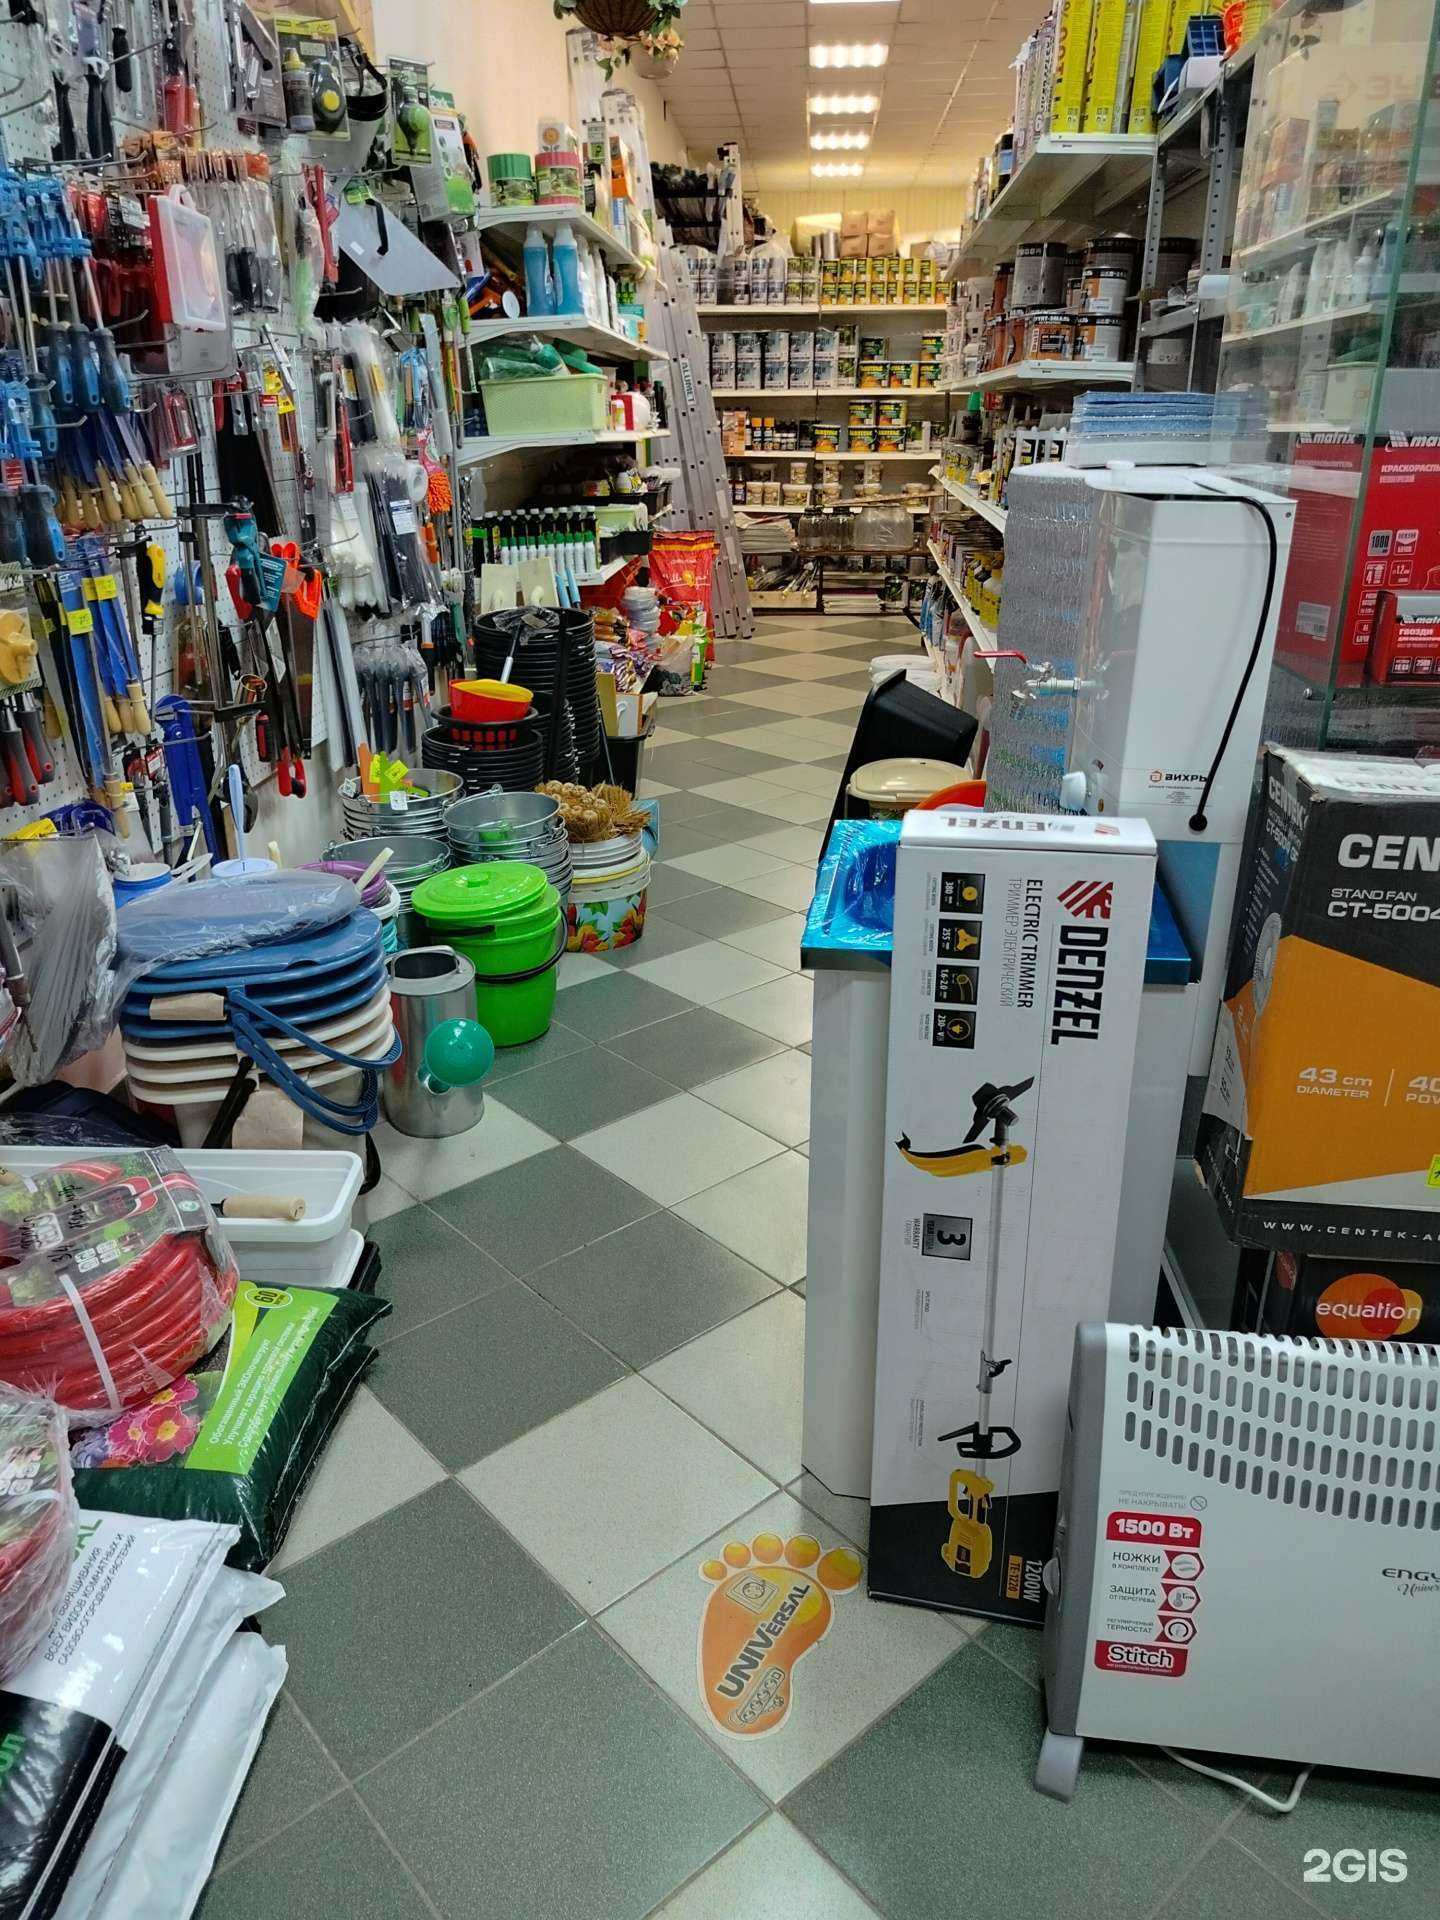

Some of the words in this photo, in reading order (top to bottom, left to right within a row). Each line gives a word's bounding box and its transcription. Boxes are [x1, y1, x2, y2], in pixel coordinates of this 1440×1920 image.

[681, 361, 695, 402] ALUMET
[1313, 433, 1356, 445] matrix
[1165, 773, 1208, 782] ВИХРЬ
[1337, 833, 1440, 872] CEN
[945, 881, 954, 895] 380
[1331, 888, 1384, 900] STAND
[1386, 890, 1417, 902] FAN
[1005, 878, 1022, 928] ТРИММЕР
[1022, 879, 1043, 942] ELECTRIC
[942, 927, 951, 940] 255
[1000, 928, 1018, 1007] ЭЛЕКТРИЧЕСКИЙ
[1017, 945, 1038, 1009] TRIMMER
[1051, 925, 1109, 1045] DENZEL
[1299, 1067, 1337, 1084] 43
[1342, 1075, 1373, 1087] cm
[1297, 1085, 1370, 1099] DIAMETER
[937, 1230, 967, 1246] 3
[254, 1290, 278, 1303] 60
[1316, 1301, 1422, 1320] equation
[1115, 1518, 1166, 1537] 1500
[1169, 1522, 1194, 1539] Вт
[1112, 1551, 1161, 1564] НОЖКИ
[1009, 1561, 1020, 1592] TE-1220
[1023, 1560, 1043, 1603] 1200W
[1110, 1585, 1157, 1596] ЗАЩИТА
[44, 1634, 64, 1662] ВСЕХ
[61, 1598, 87, 1632] ВИДОВ
[82, 1540, 120, 1600] КОМНАТНЫХ
[1106, 1624, 1152, 1633] ТЕРМОСТАТ
[716, 1584, 811, 1698] UNIVERSAL
[1109, 1645, 1174, 1668] Stitch
